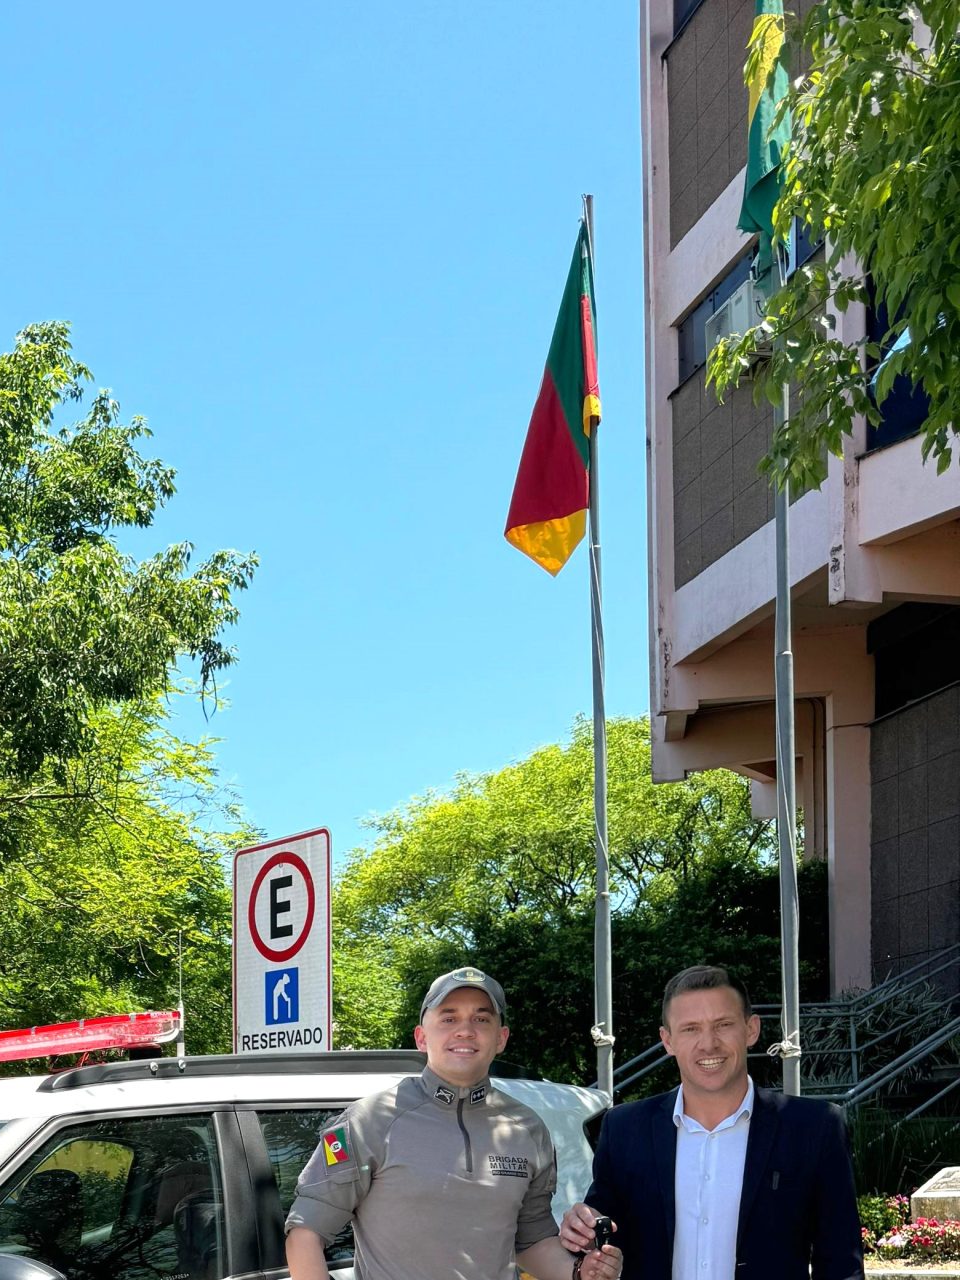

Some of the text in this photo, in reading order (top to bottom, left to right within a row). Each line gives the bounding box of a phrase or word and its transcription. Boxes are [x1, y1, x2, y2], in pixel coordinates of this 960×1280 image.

[270, 875, 293, 940] E
[242, 1026, 323, 1051] RESERVADO
[488, 1155, 529, 1165] BRIGADA
[490, 1162, 528, 1171] MILITAR
